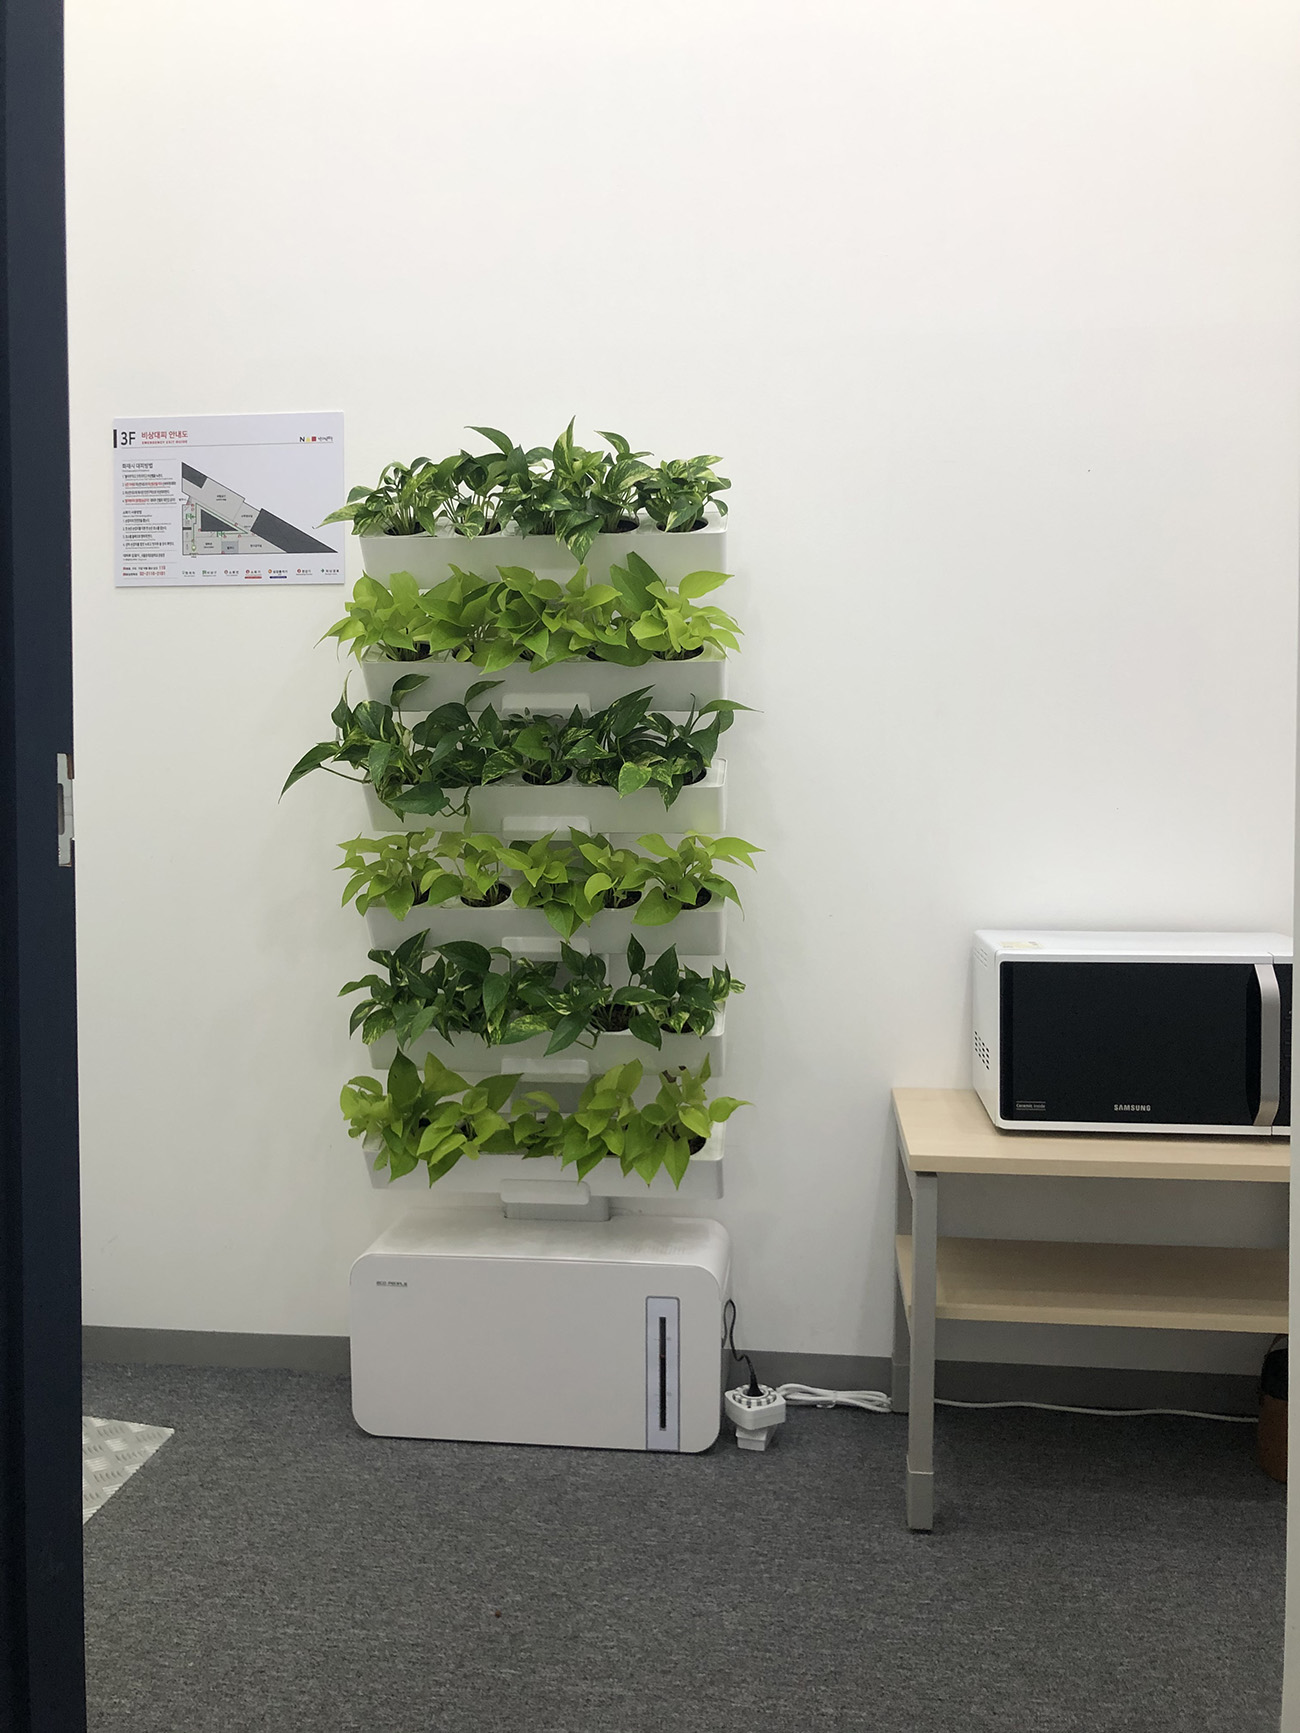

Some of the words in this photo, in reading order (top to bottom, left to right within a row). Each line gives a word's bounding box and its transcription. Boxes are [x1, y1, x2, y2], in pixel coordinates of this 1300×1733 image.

[120, 431, 136, 446] 3F
[141, 431, 167, 440] 비상대피
[168, 430, 189, 439] 안내도
[1113, 1104, 1151, 1112] SAMSUNG
